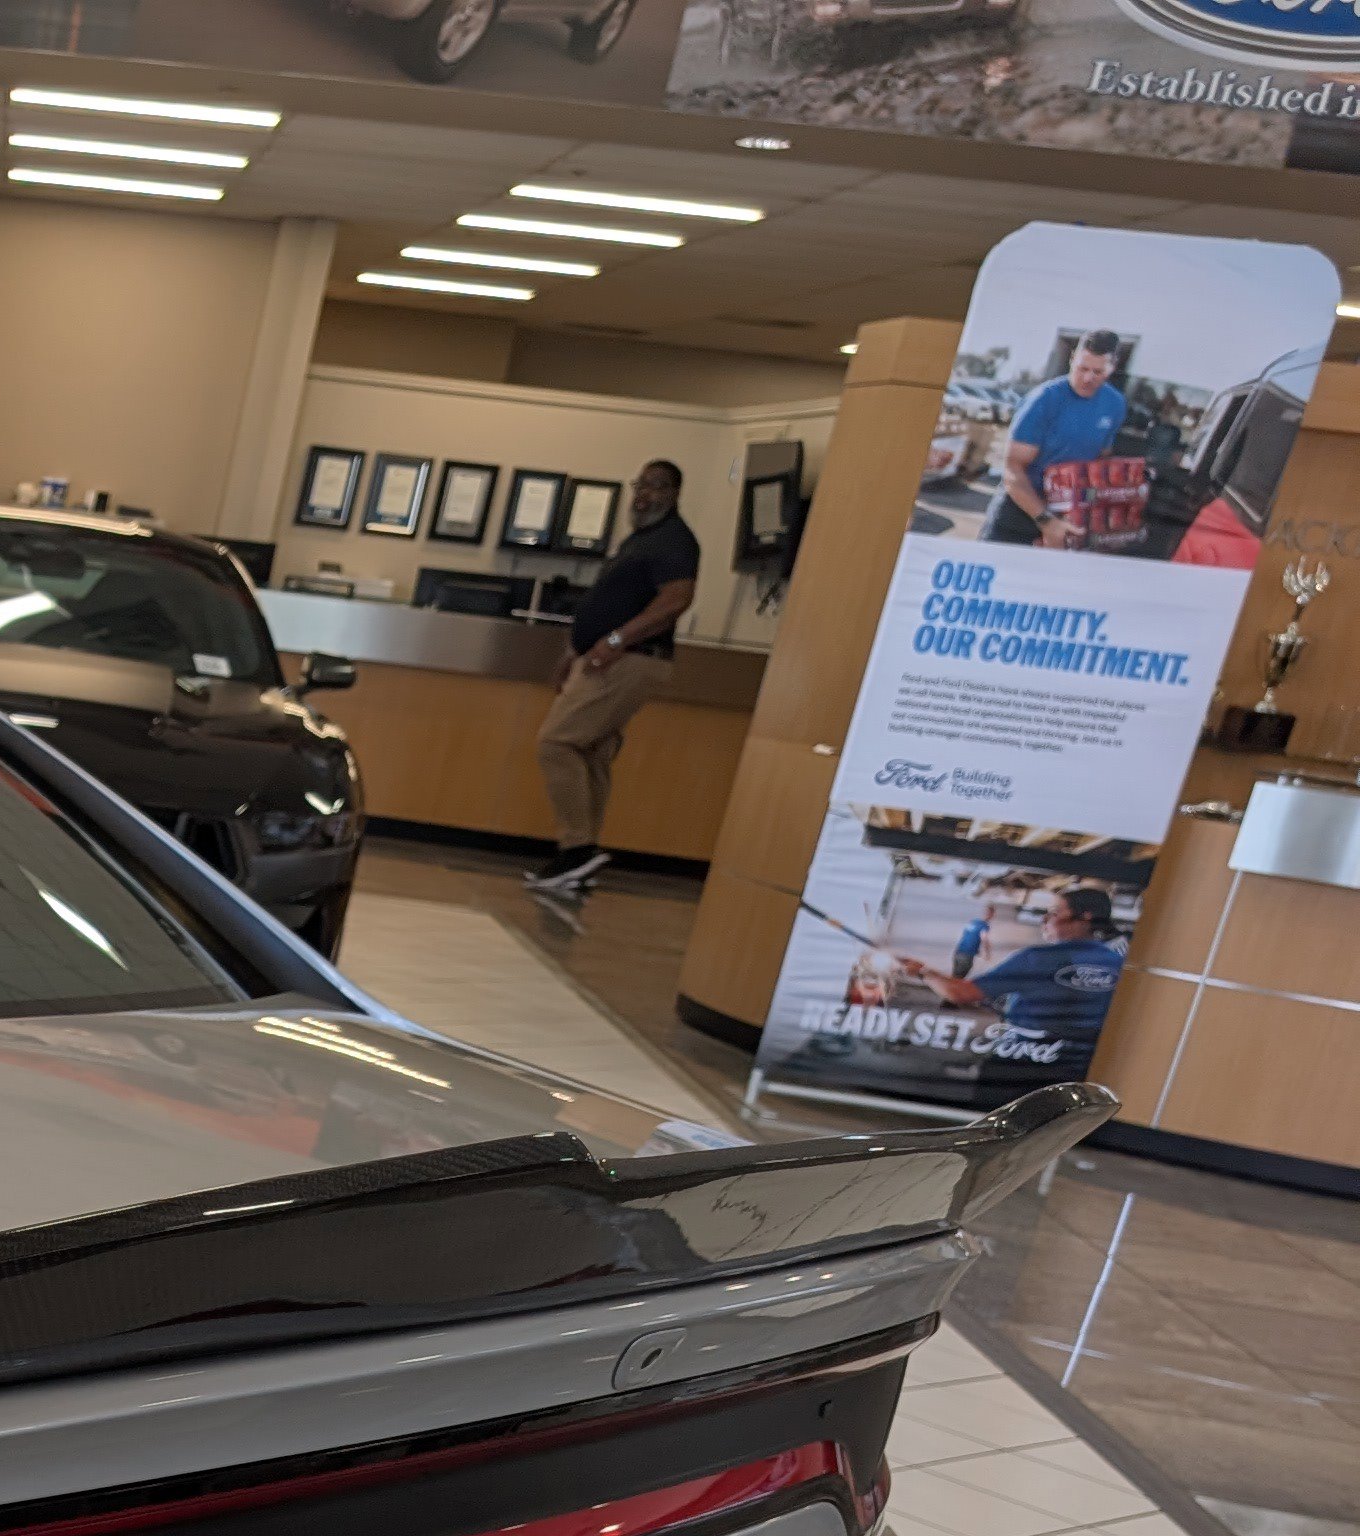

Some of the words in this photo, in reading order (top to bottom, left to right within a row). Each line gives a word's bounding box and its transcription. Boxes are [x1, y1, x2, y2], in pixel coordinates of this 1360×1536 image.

[1085, 58, 1334, 117] Established
[930, 558, 996, 595] OUR
[921, 592, 1108, 643] COMMUNITY.
[913, 624, 977, 660] OUR
[979, 632, 1189, 686] COMMITMENT.
[874, 759, 949, 793] Ford
[950, 782, 1014, 802] Together
[952, 766, 1013, 789] Building
[798, 998, 913, 1043] READY
[910, 1013, 977, 1051] SET
[970, 1022, 1065, 1064] Ford
